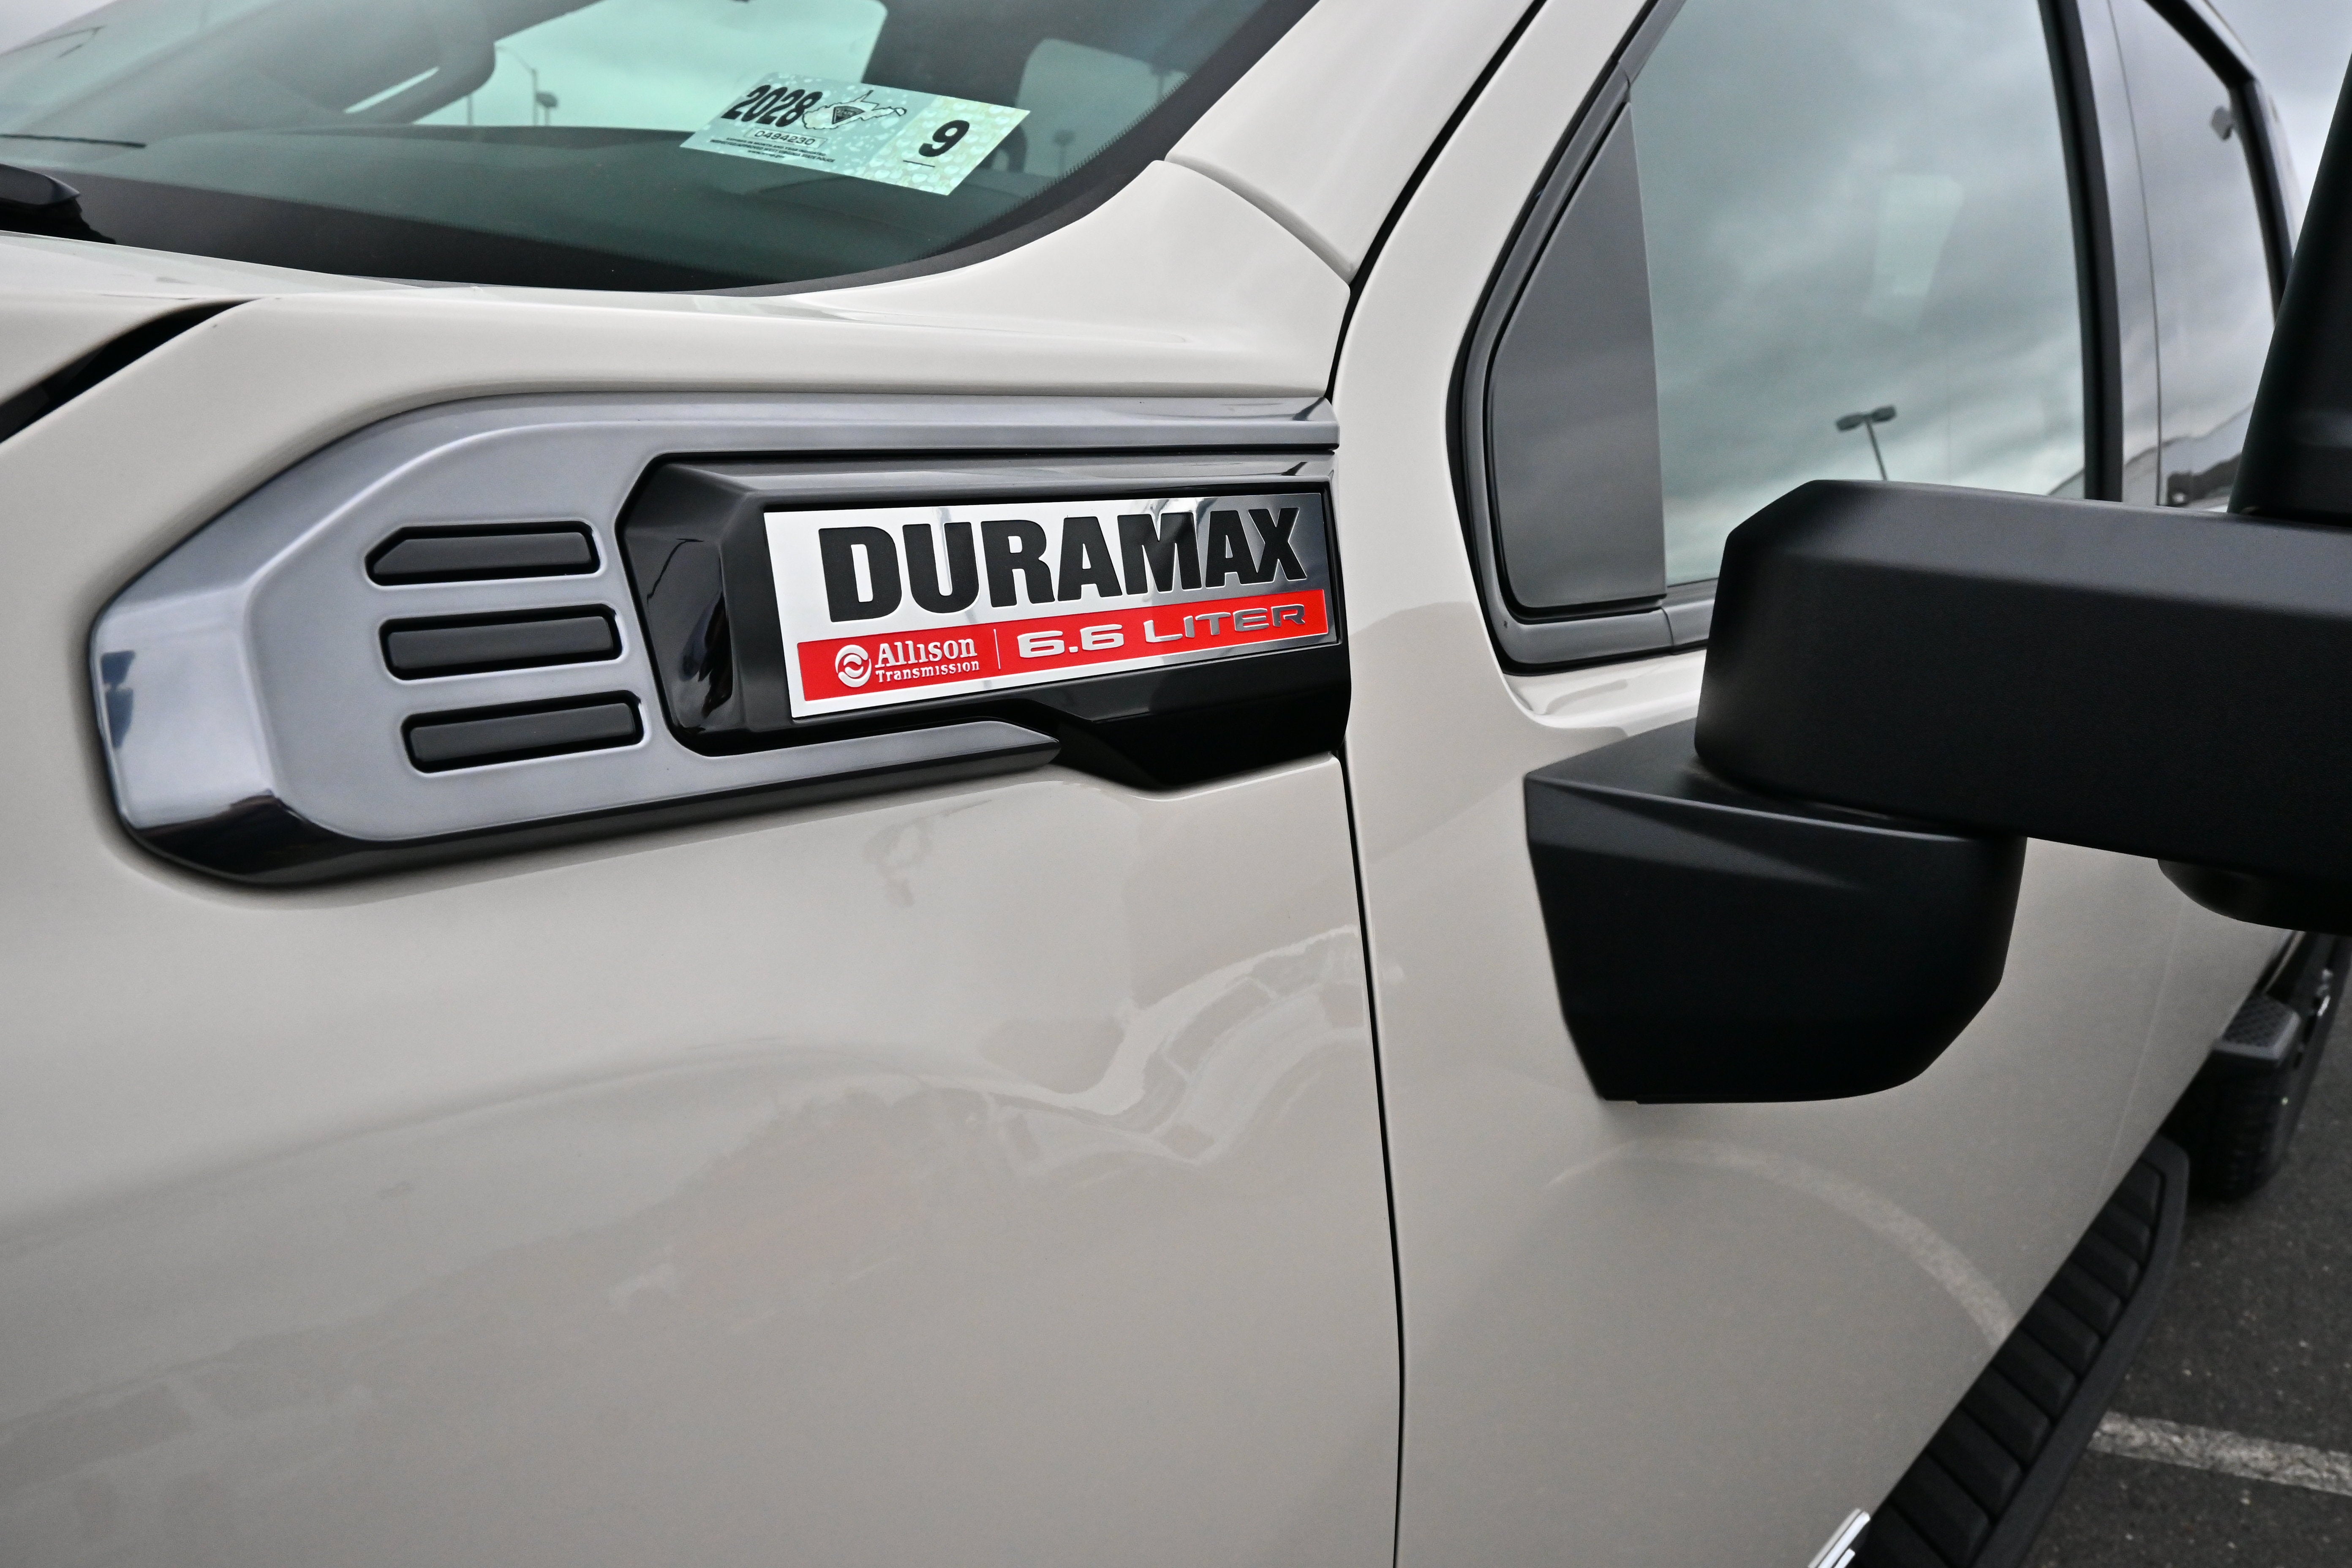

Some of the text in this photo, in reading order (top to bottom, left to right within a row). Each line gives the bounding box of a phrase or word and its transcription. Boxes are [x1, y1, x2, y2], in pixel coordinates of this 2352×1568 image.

[721, 84, 823, 127] 2028
[754, 131, 816, 145] 0494230
[918, 120, 970, 157] 9
[819, 508, 1307, 623] DURAMAX
[1017, 604, 1306, 658] 6.6 LITER
[874, 638, 978, 668] Allison
[875, 661, 980, 683] Transmission
